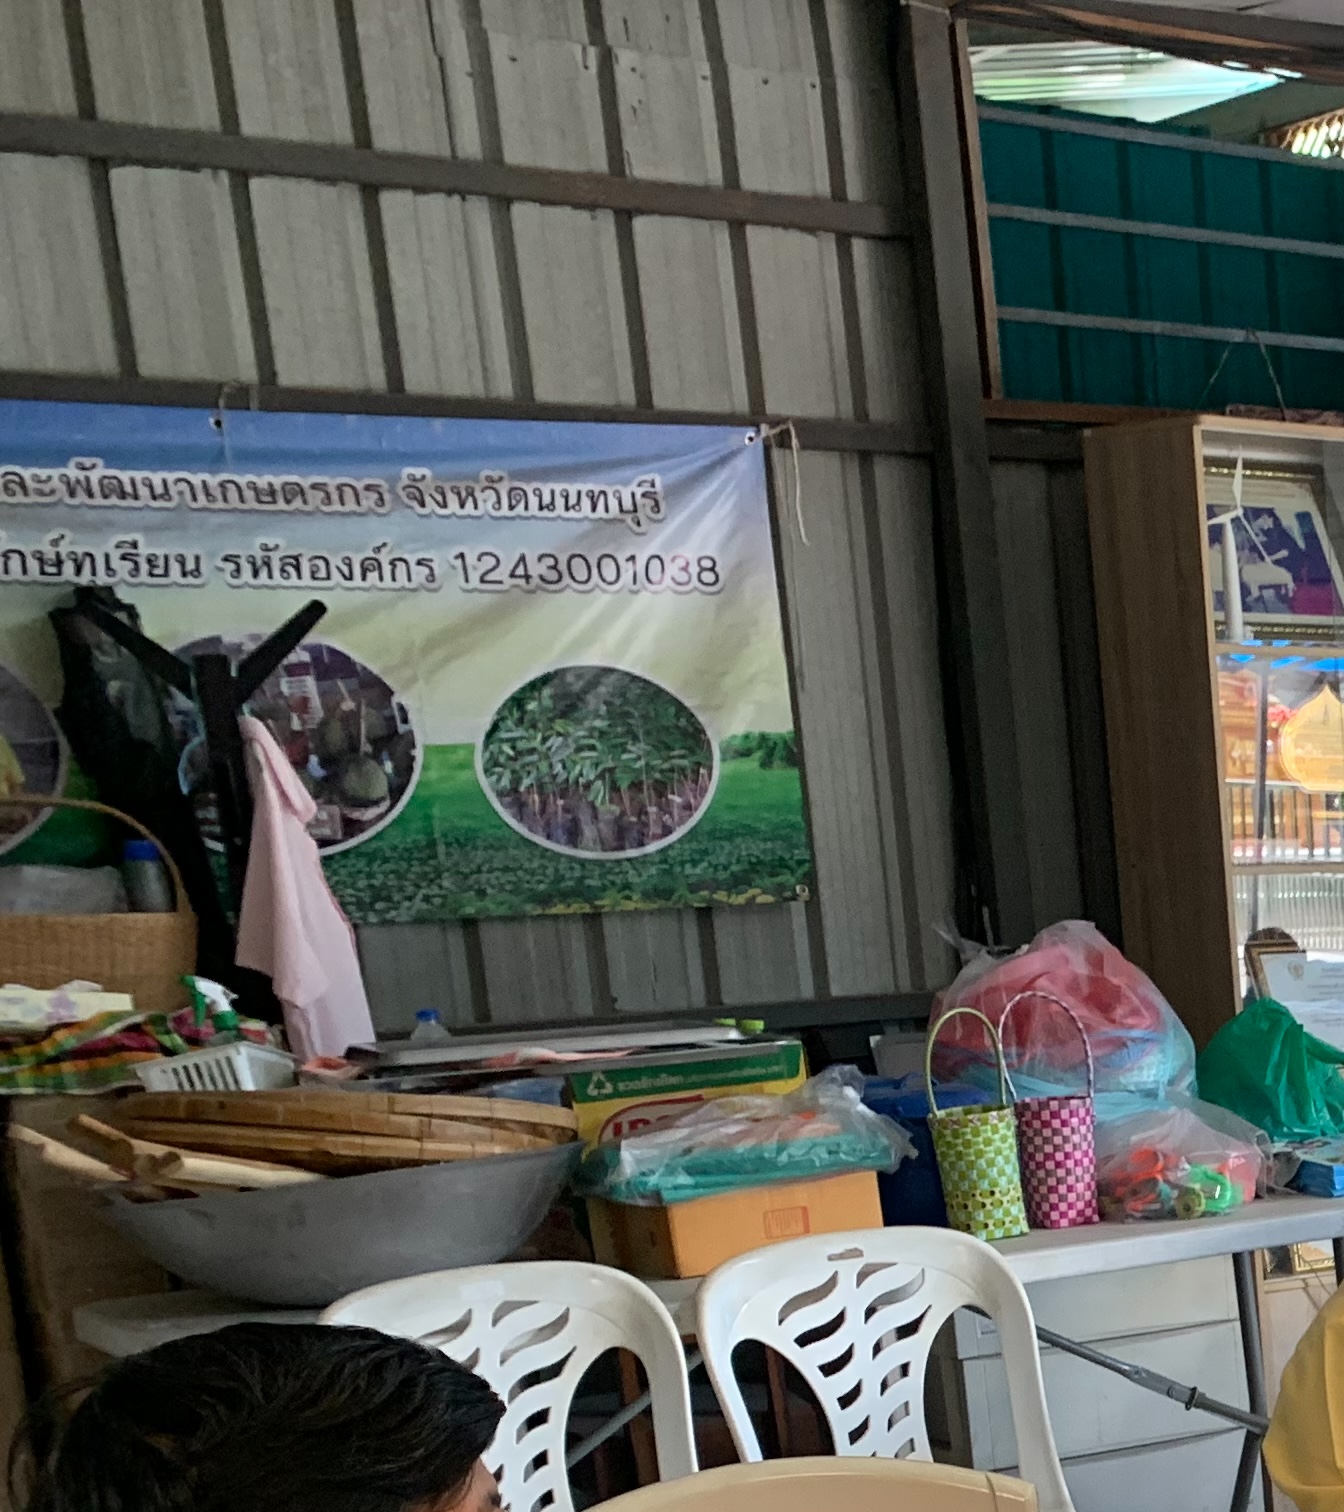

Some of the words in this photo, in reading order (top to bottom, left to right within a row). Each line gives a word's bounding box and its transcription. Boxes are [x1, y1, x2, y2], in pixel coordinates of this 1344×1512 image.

[401, 473, 662, 526] จังหวัดนนทบุรี
[221, 541, 435, 584] รหัสองค์กร
[455, 551, 720, 587] 1243001038
